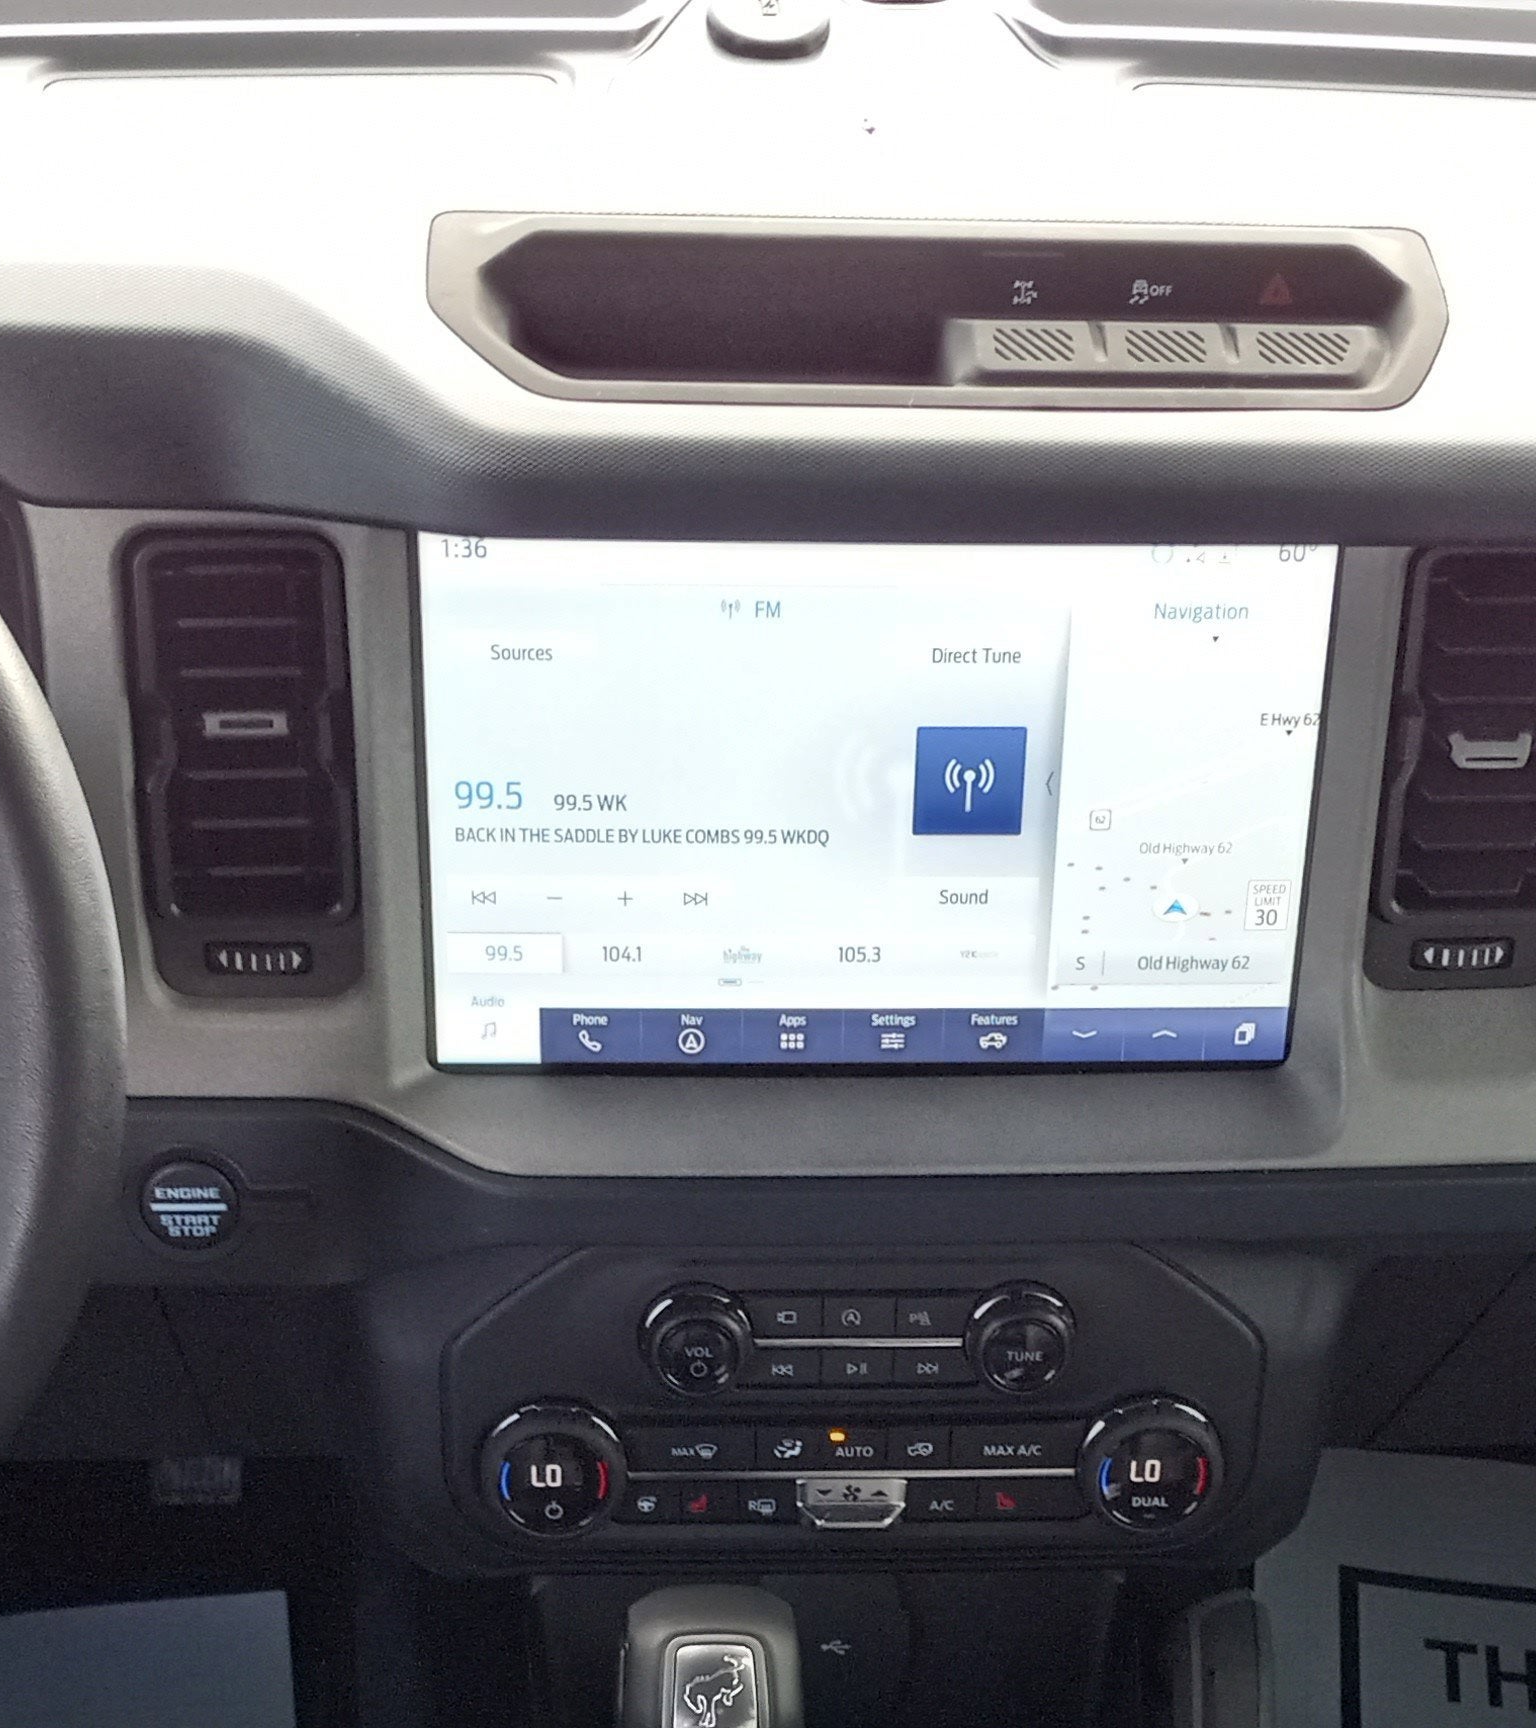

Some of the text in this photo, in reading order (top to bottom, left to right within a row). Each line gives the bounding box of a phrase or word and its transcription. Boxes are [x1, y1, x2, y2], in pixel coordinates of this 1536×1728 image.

[1149, 284, 1172, 297] OFF
[440, 539, 487, 558] 1:36
[754, 601, 782, 619] FM
[1154, 602, 1249, 623] Navigation
[490, 645, 553, 662] Sources
[932, 647, 1022, 664] Direct Tune
[1260, 713, 1320, 729] E Hwy 62
[454, 780, 523, 810] 99.5
[553, 794, 628, 812] 99.5 WK
[454, 827, 830, 848] BACK IN THE SADDLE BY LUKE COMBS 99.5 WKDQ
[1139, 841, 1233, 858] Old Highway 62
[1252, 883, 1287, 895] SPEED
[938, 889, 989, 906] Sound
[1254, 896, 1282, 907] LIMIT
[1254, 909, 1278, 927] 30
[485, 946, 523, 963] 99.5
[602, 946, 642, 963] 104.1
[838, 947, 881, 963] 105.3
[1075, 956, 1086, 971] S
[1137, 955, 1250, 974] Old Highway 62
[471, 996, 505, 1008] Audio
[572, 1014, 608, 1027] Phone
[680, 1014, 703, 1027] Nav
[779, 1014, 807, 1028] Apps
[871, 1013, 916, 1028] Settings
[970, 1013, 1018, 1027] Features
[154, 1187, 221, 1199] ENGINE
[159, 1214, 221, 1226] START
[167, 1226, 217, 1237] STOP
[684, 1347, 714, 1358] VOL
[1007, 1351, 1043, 1362] TUNE
[671, 1447, 695, 1457] MAX
[835, 1446, 874, 1458] AUTO
[983, 1444, 1042, 1457] MAX A/C
[531, 1464, 563, 1488] LO
[1130, 1459, 1161, 1483] LO
[930, 1500, 954, 1512] A/C
[1132, 1496, 1169, 1508] DUAL
